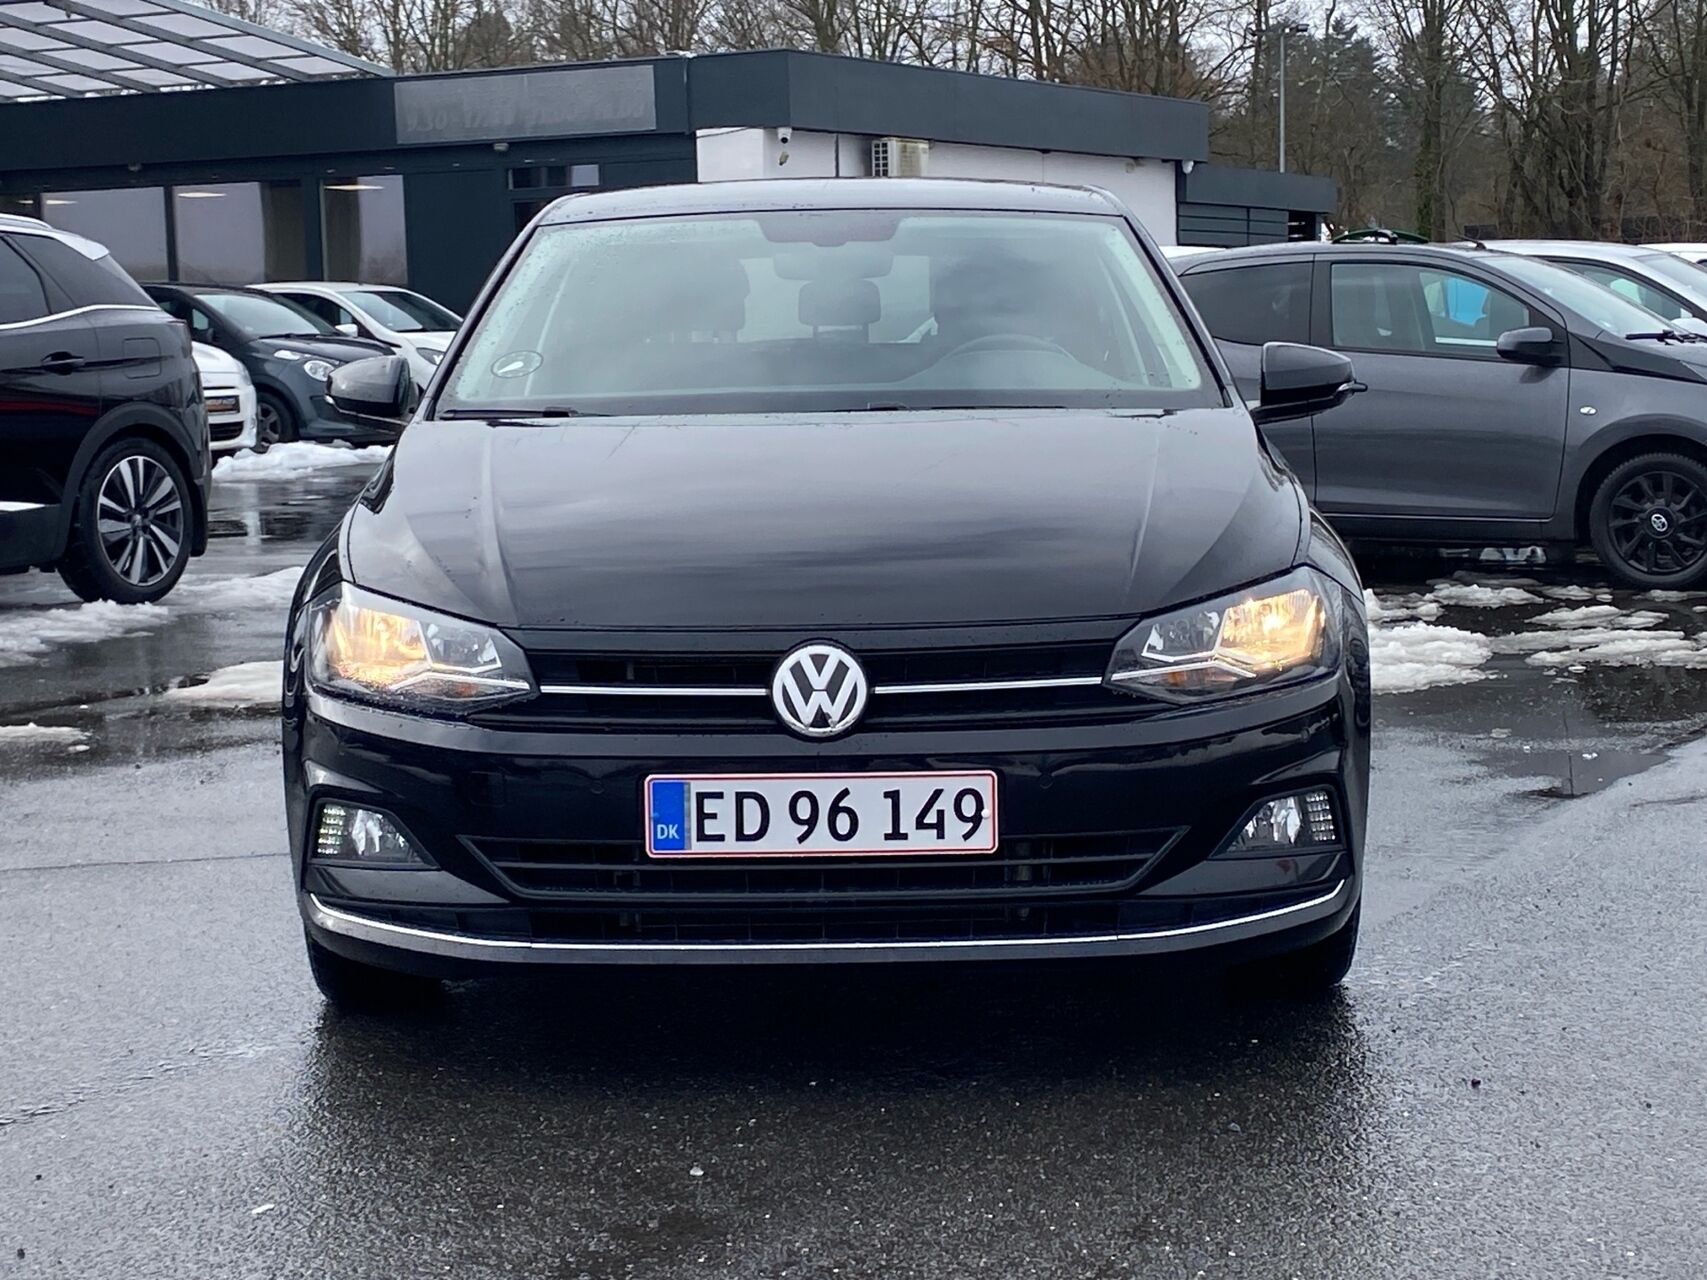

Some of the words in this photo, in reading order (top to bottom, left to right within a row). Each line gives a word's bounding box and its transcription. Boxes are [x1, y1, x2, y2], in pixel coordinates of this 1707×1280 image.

[777, 650, 863, 732] VW
[656, 823, 680, 840] DK
[695, 791, 770, 842] ED
[788, 787, 859, 844] 96
[883, 788, 985, 841] 149
